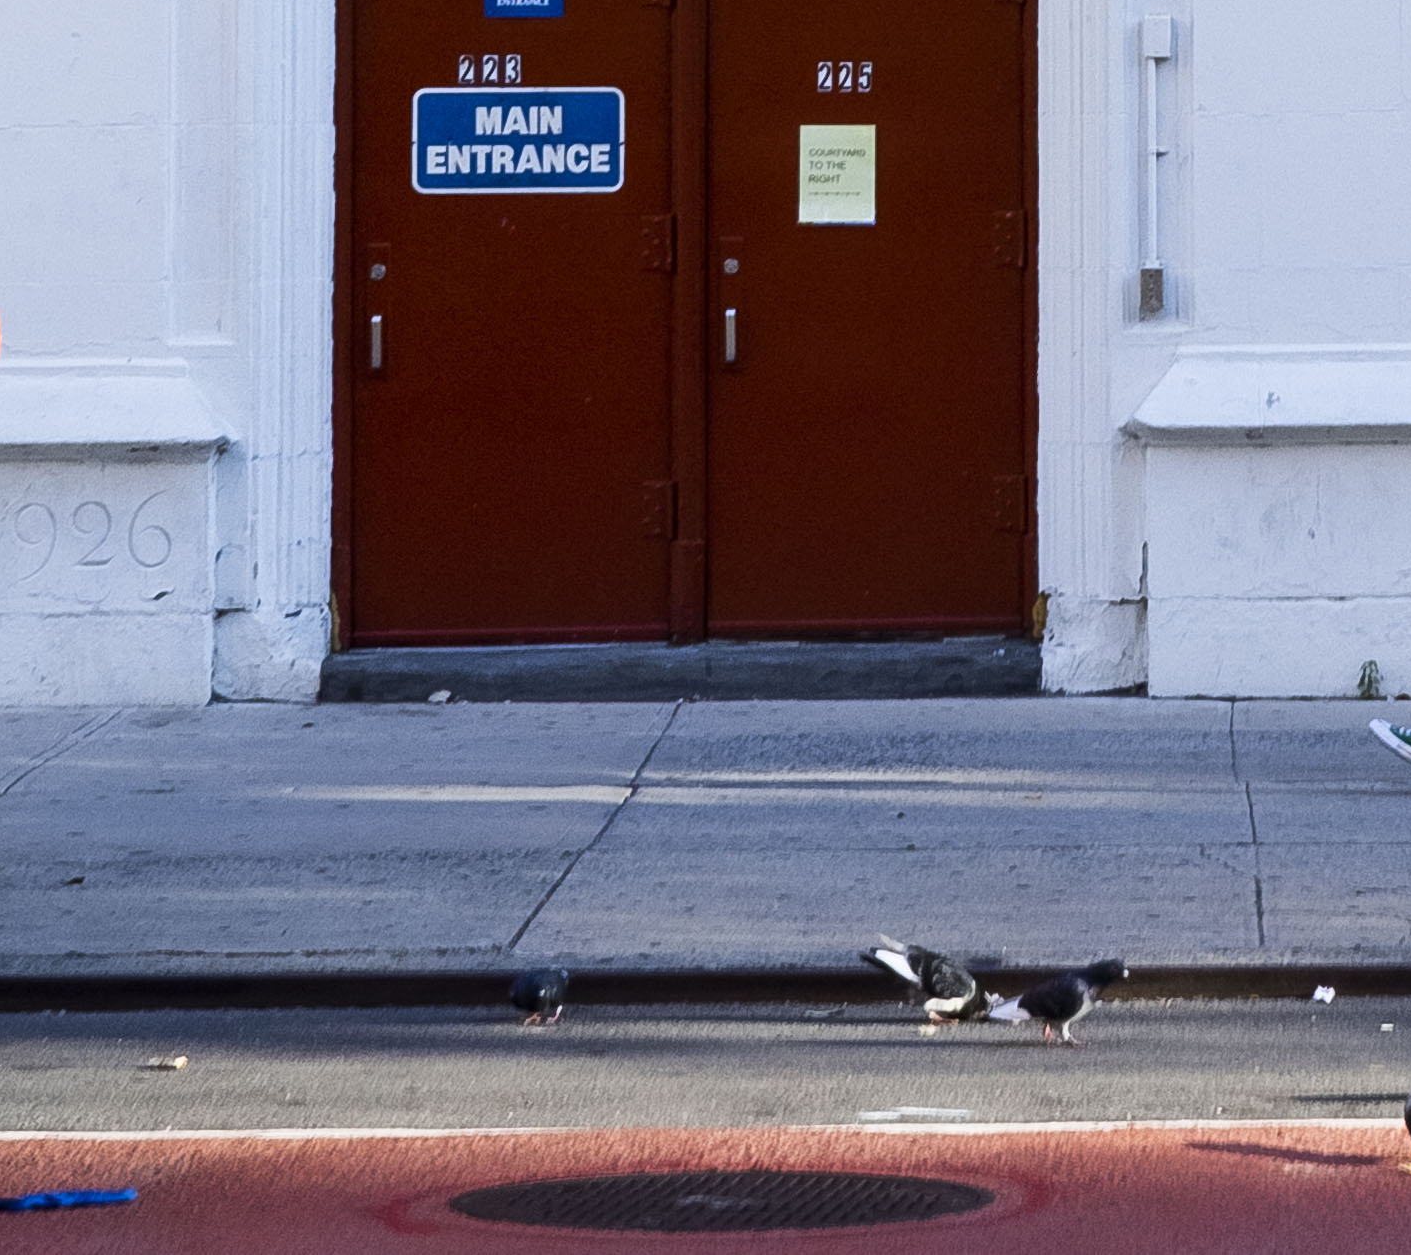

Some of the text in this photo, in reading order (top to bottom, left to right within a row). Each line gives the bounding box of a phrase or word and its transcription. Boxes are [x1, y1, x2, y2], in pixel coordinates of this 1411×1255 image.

[458, 55, 521, 83] 223
[817, 62, 873, 91] 225
[475, 105, 563, 135] MAIN
[426, 144, 611, 175] ENTRANCE
[809, 160, 847, 170] TO THE
[808, 174, 841, 184] RIGHT
